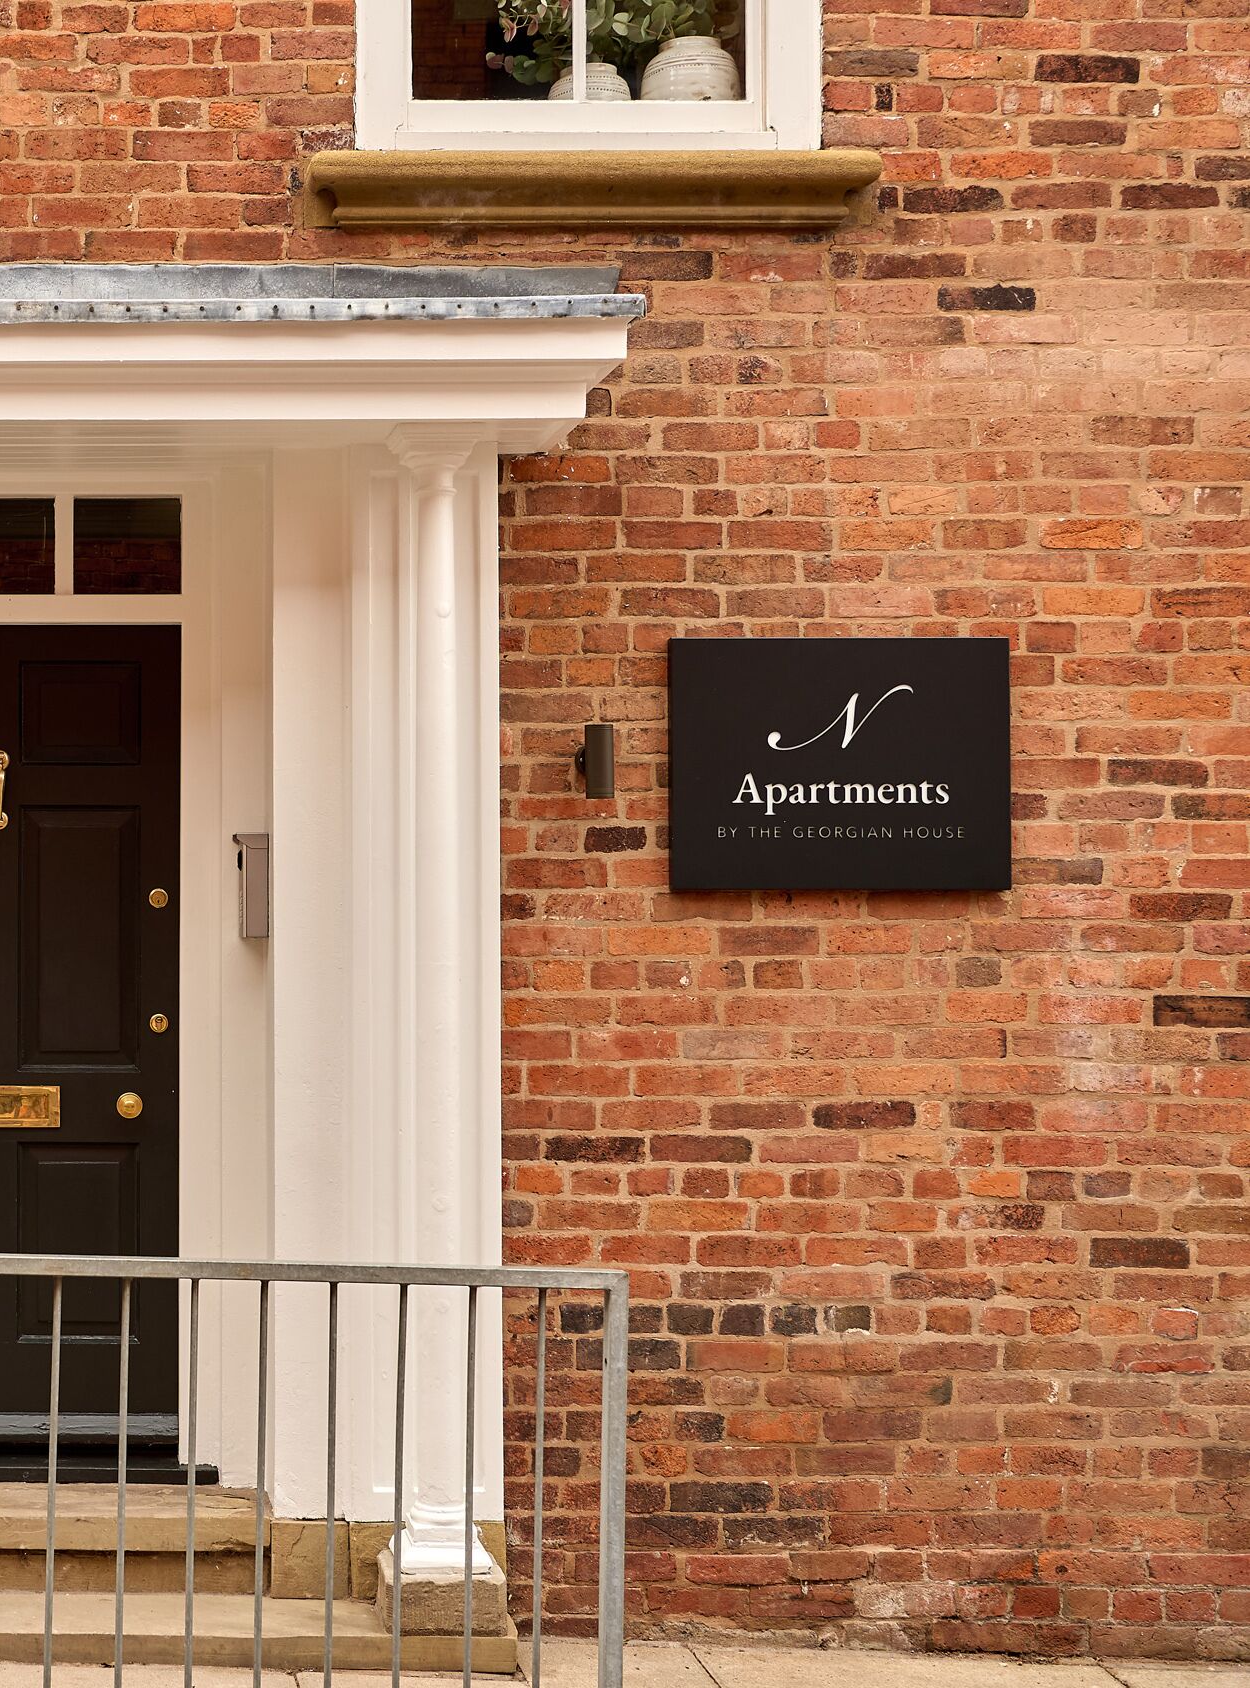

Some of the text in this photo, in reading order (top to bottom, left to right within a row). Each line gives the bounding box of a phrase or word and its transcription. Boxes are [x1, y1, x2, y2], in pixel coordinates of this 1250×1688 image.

[767, 684, 914, 751] N
[731, 772, 950, 816] Apartments
[717, 825, 966, 839] BY THE GEORGIAN HOUSE
